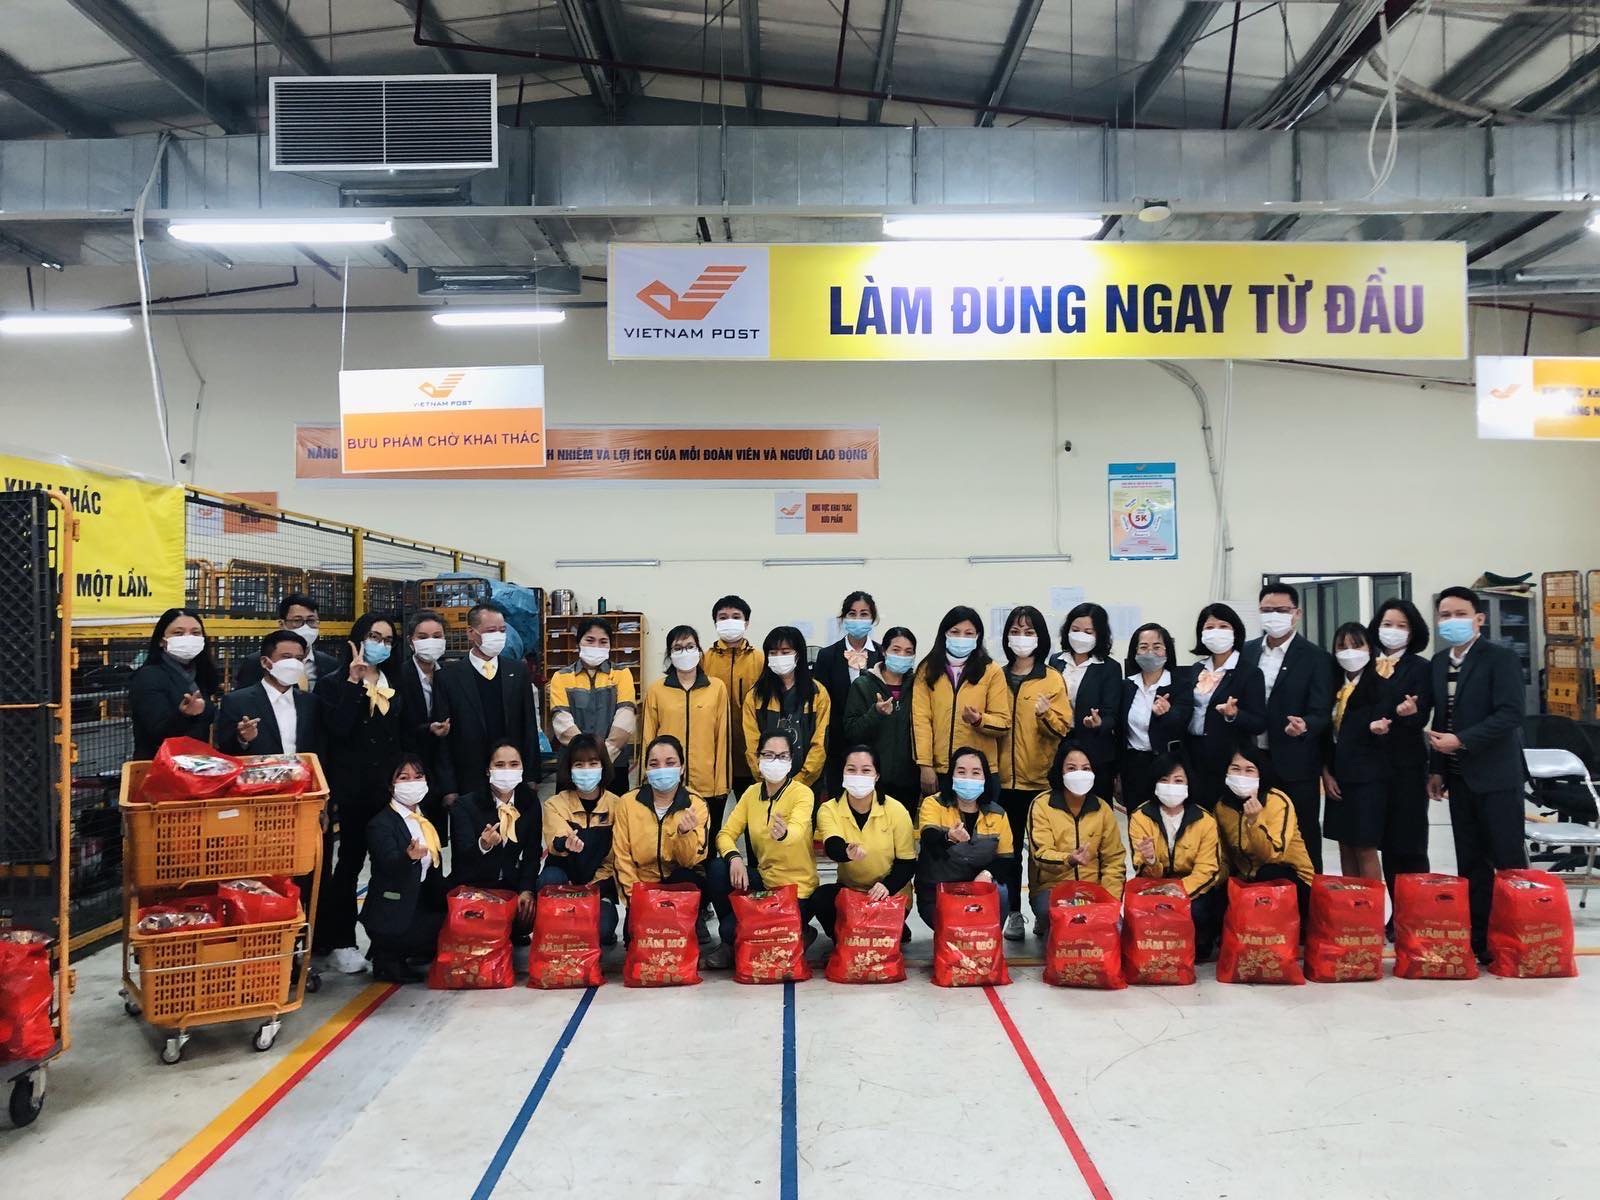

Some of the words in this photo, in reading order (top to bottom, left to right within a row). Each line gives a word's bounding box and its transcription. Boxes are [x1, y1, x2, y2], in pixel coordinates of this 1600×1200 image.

[829, 275, 933, 336] LÀM
[950, 276, 1086, 336] ĐÚNG
[1105, 284, 1233, 334] NGAY
[1248, 273, 1313, 335] TỪ
[1324, 266, 1424, 335] ĐẦU
[624, 328, 704, 340] VIETNAM
[712, 328, 760, 340] POST
[347, 437, 378, 449] BƯU
[427, 431, 460, 447] CHỜ
[463, 433, 498, 446] KHAI
[502, 430, 540, 445] THÁC
[557, 447, 593, 463] NHIỆM
[596, 446, 610, 460] VÀ
[613, 448, 630, 463] LỢI
[633, 446, 651, 460] ÍCH
[654, 445, 677, 461] CỦA
[703, 446, 733, 461] ĐOÀN
[736, 446, 760, 460] VIÊN
[763, 446, 777, 461] VÀ
[780, 446, 813, 461] NGƯỜI
[816, 448, 835, 461] LAO
[838, 447, 868, 463] ĐỘNG
[76, 569, 113, 603] MỘT
[667, 936, 688, 949] MỚ
